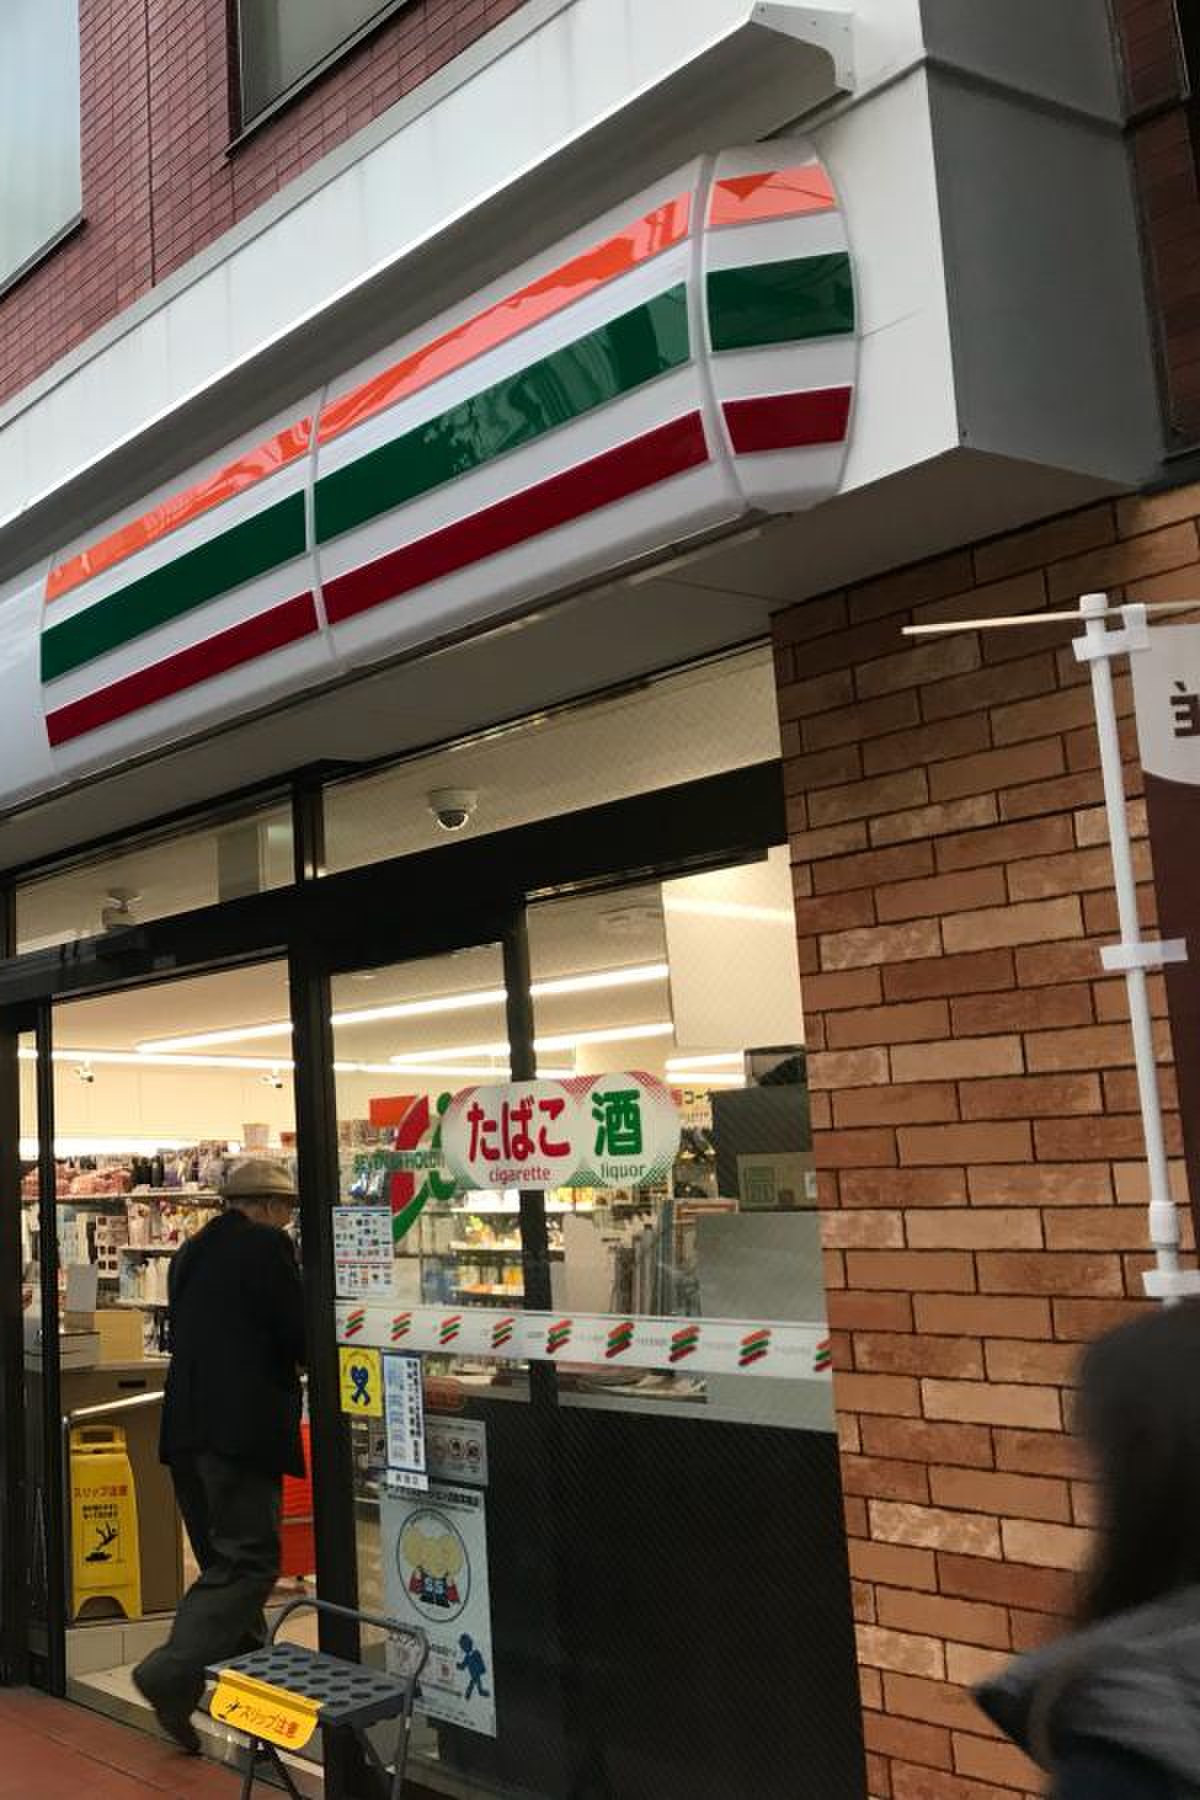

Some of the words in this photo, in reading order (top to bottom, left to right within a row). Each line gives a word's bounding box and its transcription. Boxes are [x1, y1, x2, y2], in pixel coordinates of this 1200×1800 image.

[467, 1095, 571, 1164] たばこ
[592, 1089, 643, 1156] 酒
[489, 1167, 550, 1185] cigarette
[601, 1163, 646, 1181] liquor
